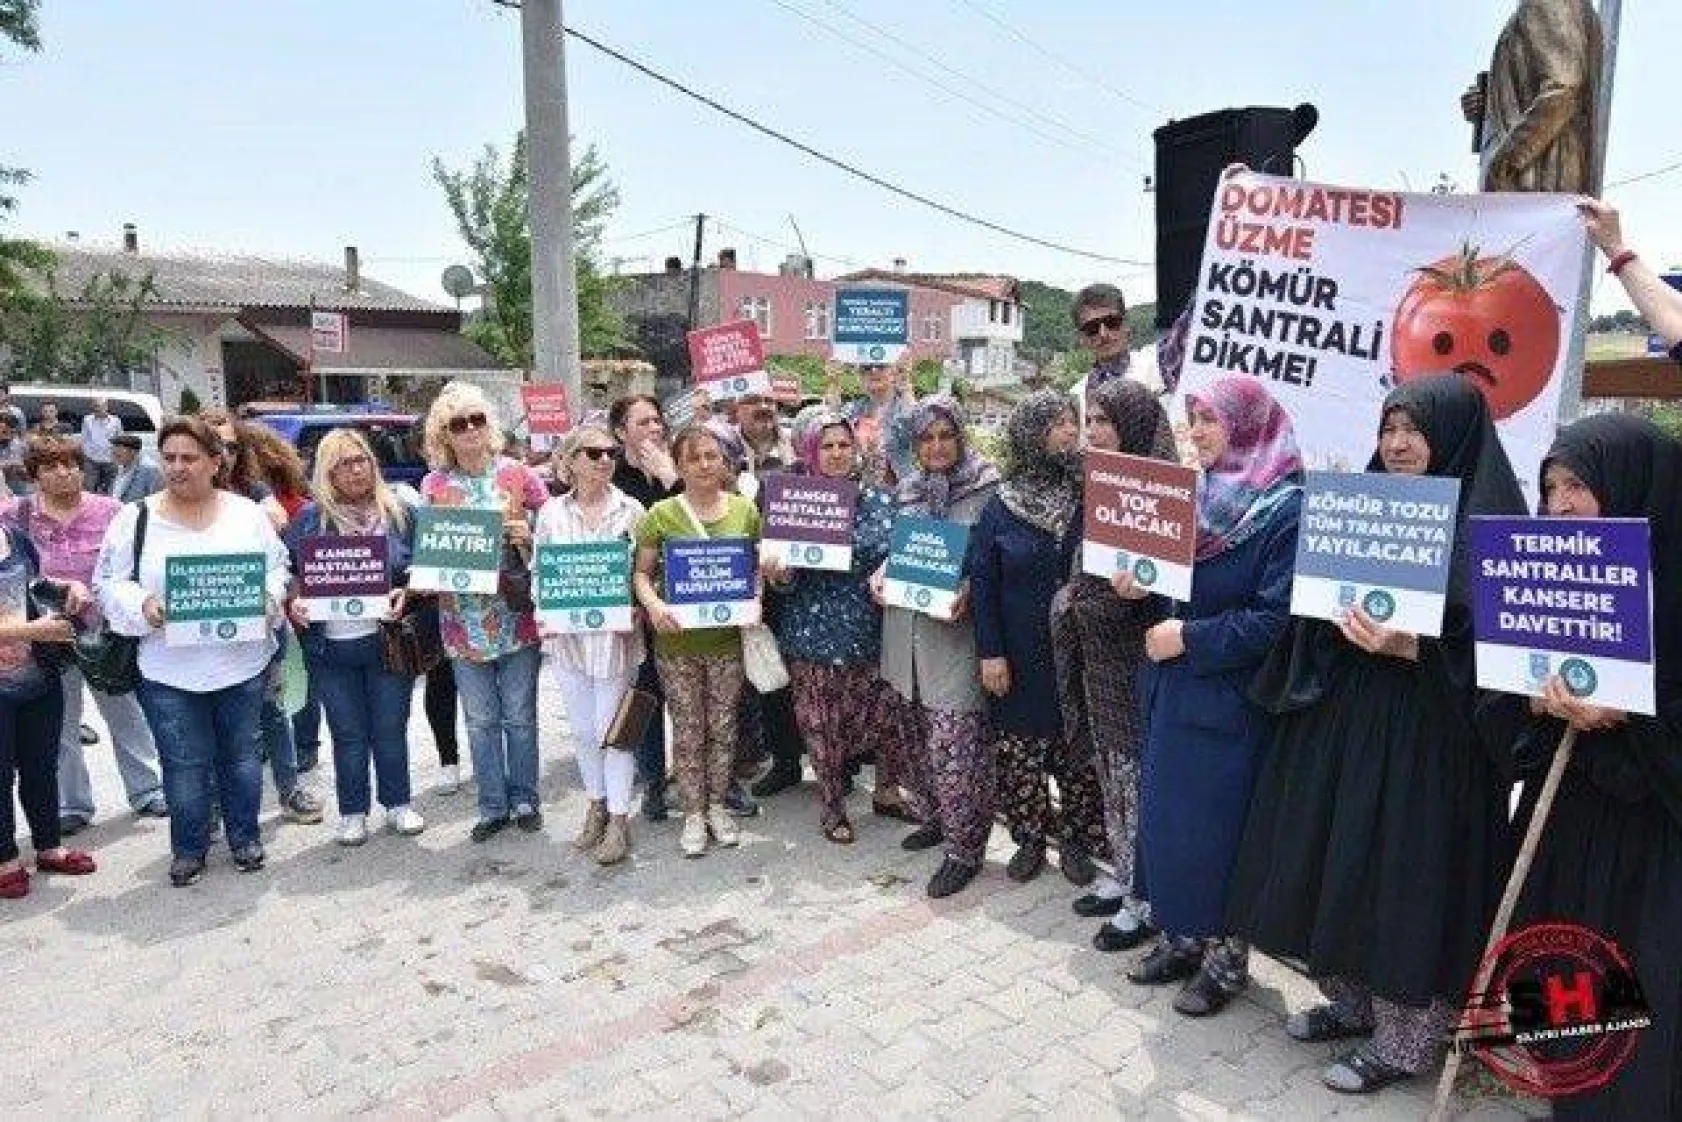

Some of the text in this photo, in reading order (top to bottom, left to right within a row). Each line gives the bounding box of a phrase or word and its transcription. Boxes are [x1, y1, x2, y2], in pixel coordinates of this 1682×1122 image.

[1216, 215, 1315, 259] ÜZME
[1208, 259, 1338, 311] KÖMÜR
[1200, 299, 1384, 361] SANTRALİ
[1192, 333, 1318, 387] DİKME!
[781, 488, 839, 503] KANSER
[1117, 490, 1160, 516] YOK
[1308, 492, 1450, 521] KÖMÜR TOZU
[1095, 504, 1182, 541] OLACAK!
[1305, 513, 1343, 532] TÜM
[314, 548, 372, 559] KANSER
[420, 532, 496, 553] HAYIR!
[1306, 534, 1444, 567] YAYILACAK!
[1511, 529, 1602, 557] TERMİK
[689, 564, 733, 579] ÖLÜM
[1481, 559, 1639, 587] SANTRALLER
[1503, 586, 1616, 622] KANSERE
[1499, 612, 1623, 642] DAVETTİR!
